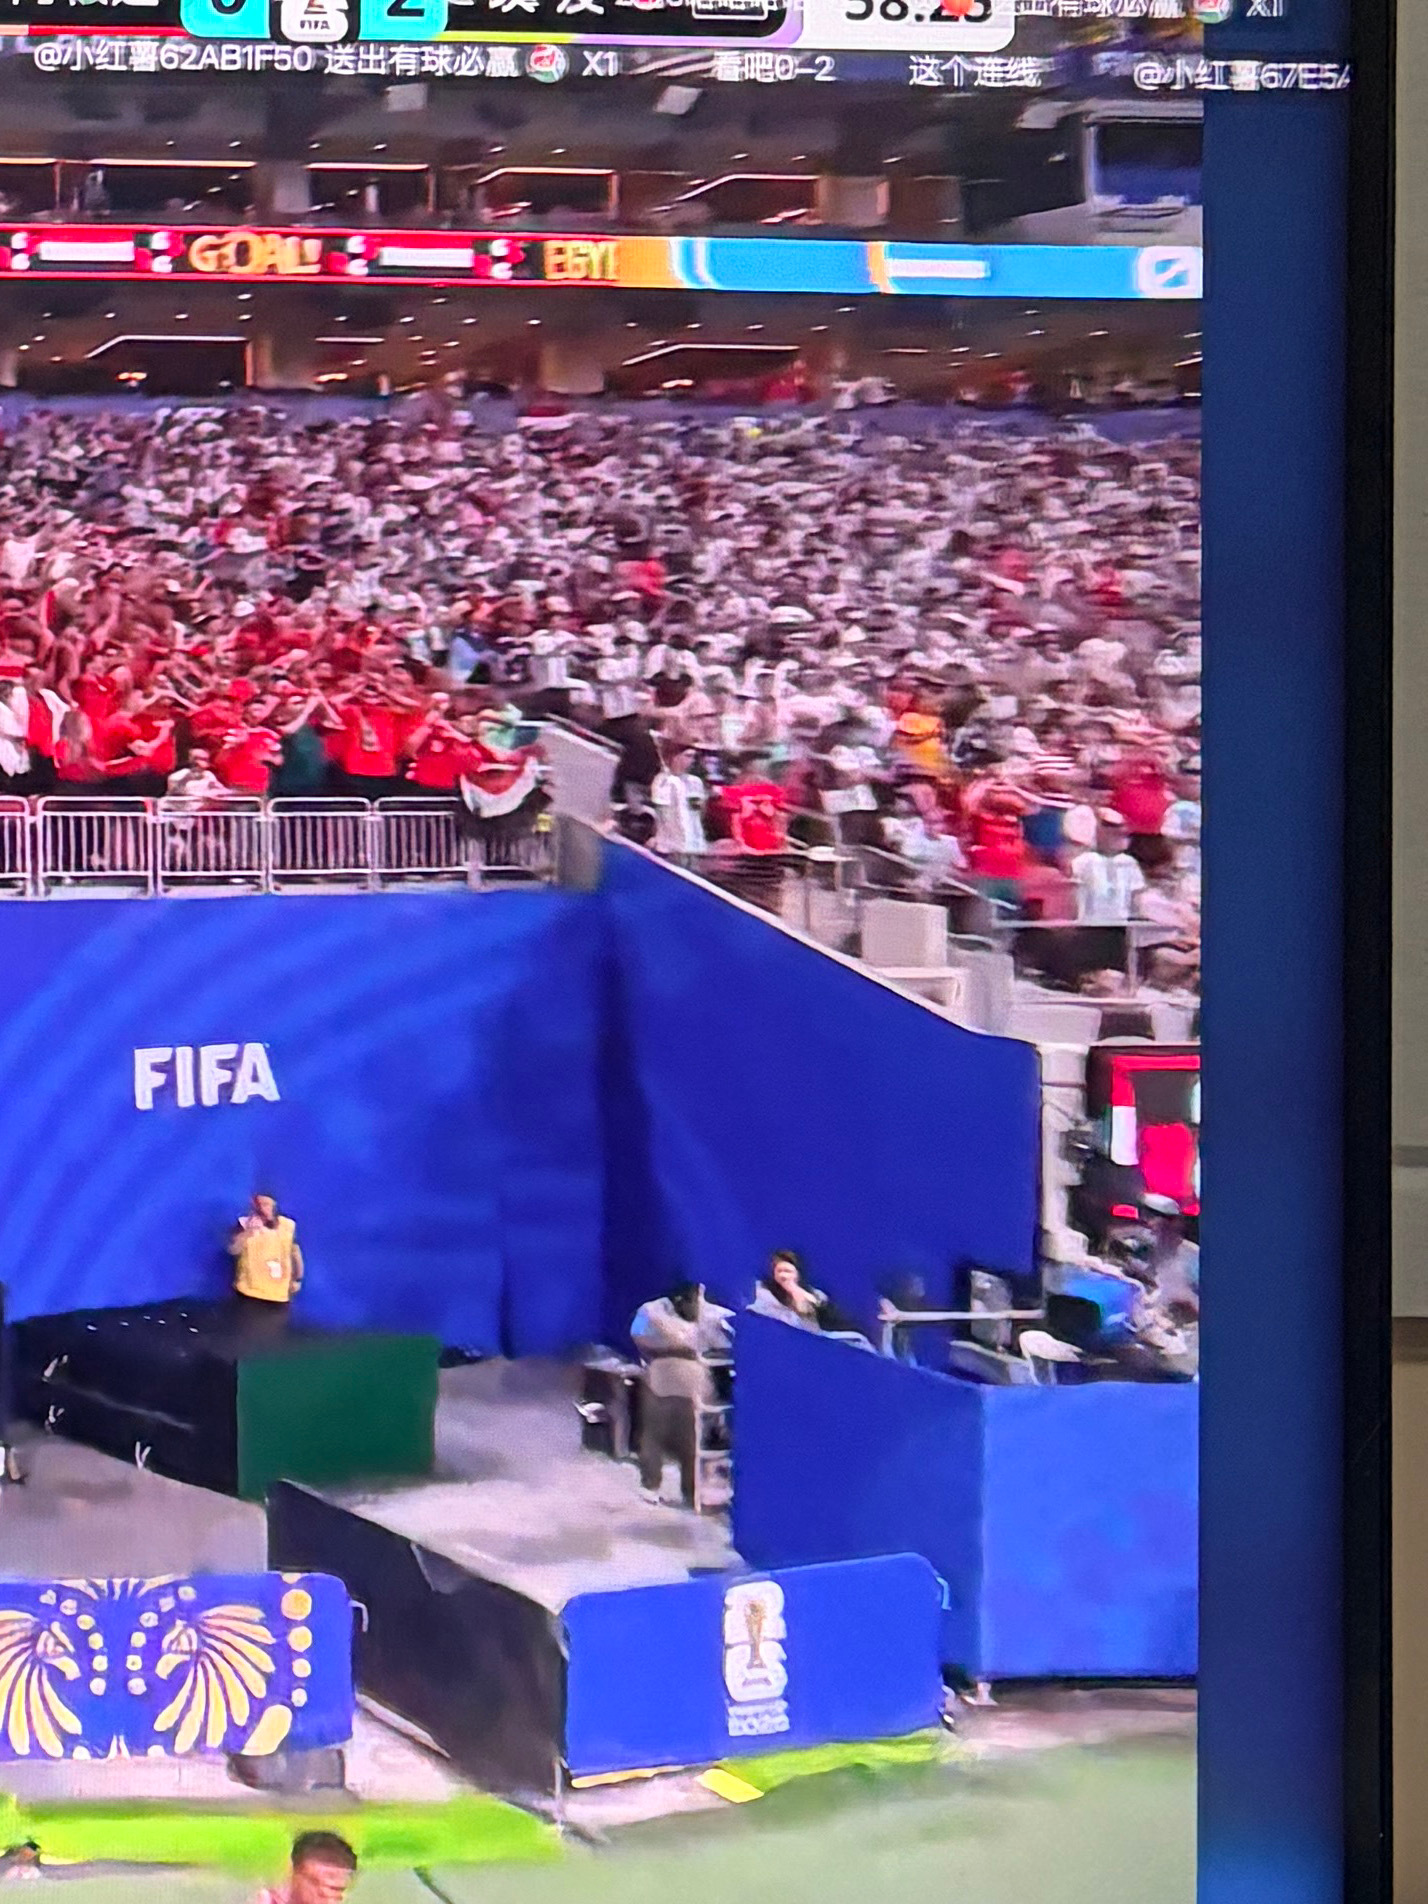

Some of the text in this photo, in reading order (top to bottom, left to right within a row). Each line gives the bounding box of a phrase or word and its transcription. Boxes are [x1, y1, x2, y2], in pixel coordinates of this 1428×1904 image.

[299, 19, 331, 31] FIFA
[324, 44, 520, 79] 送出有球必赢
[583, 50, 621, 78] X1
[133, 1042, 282, 1110] FIFA
